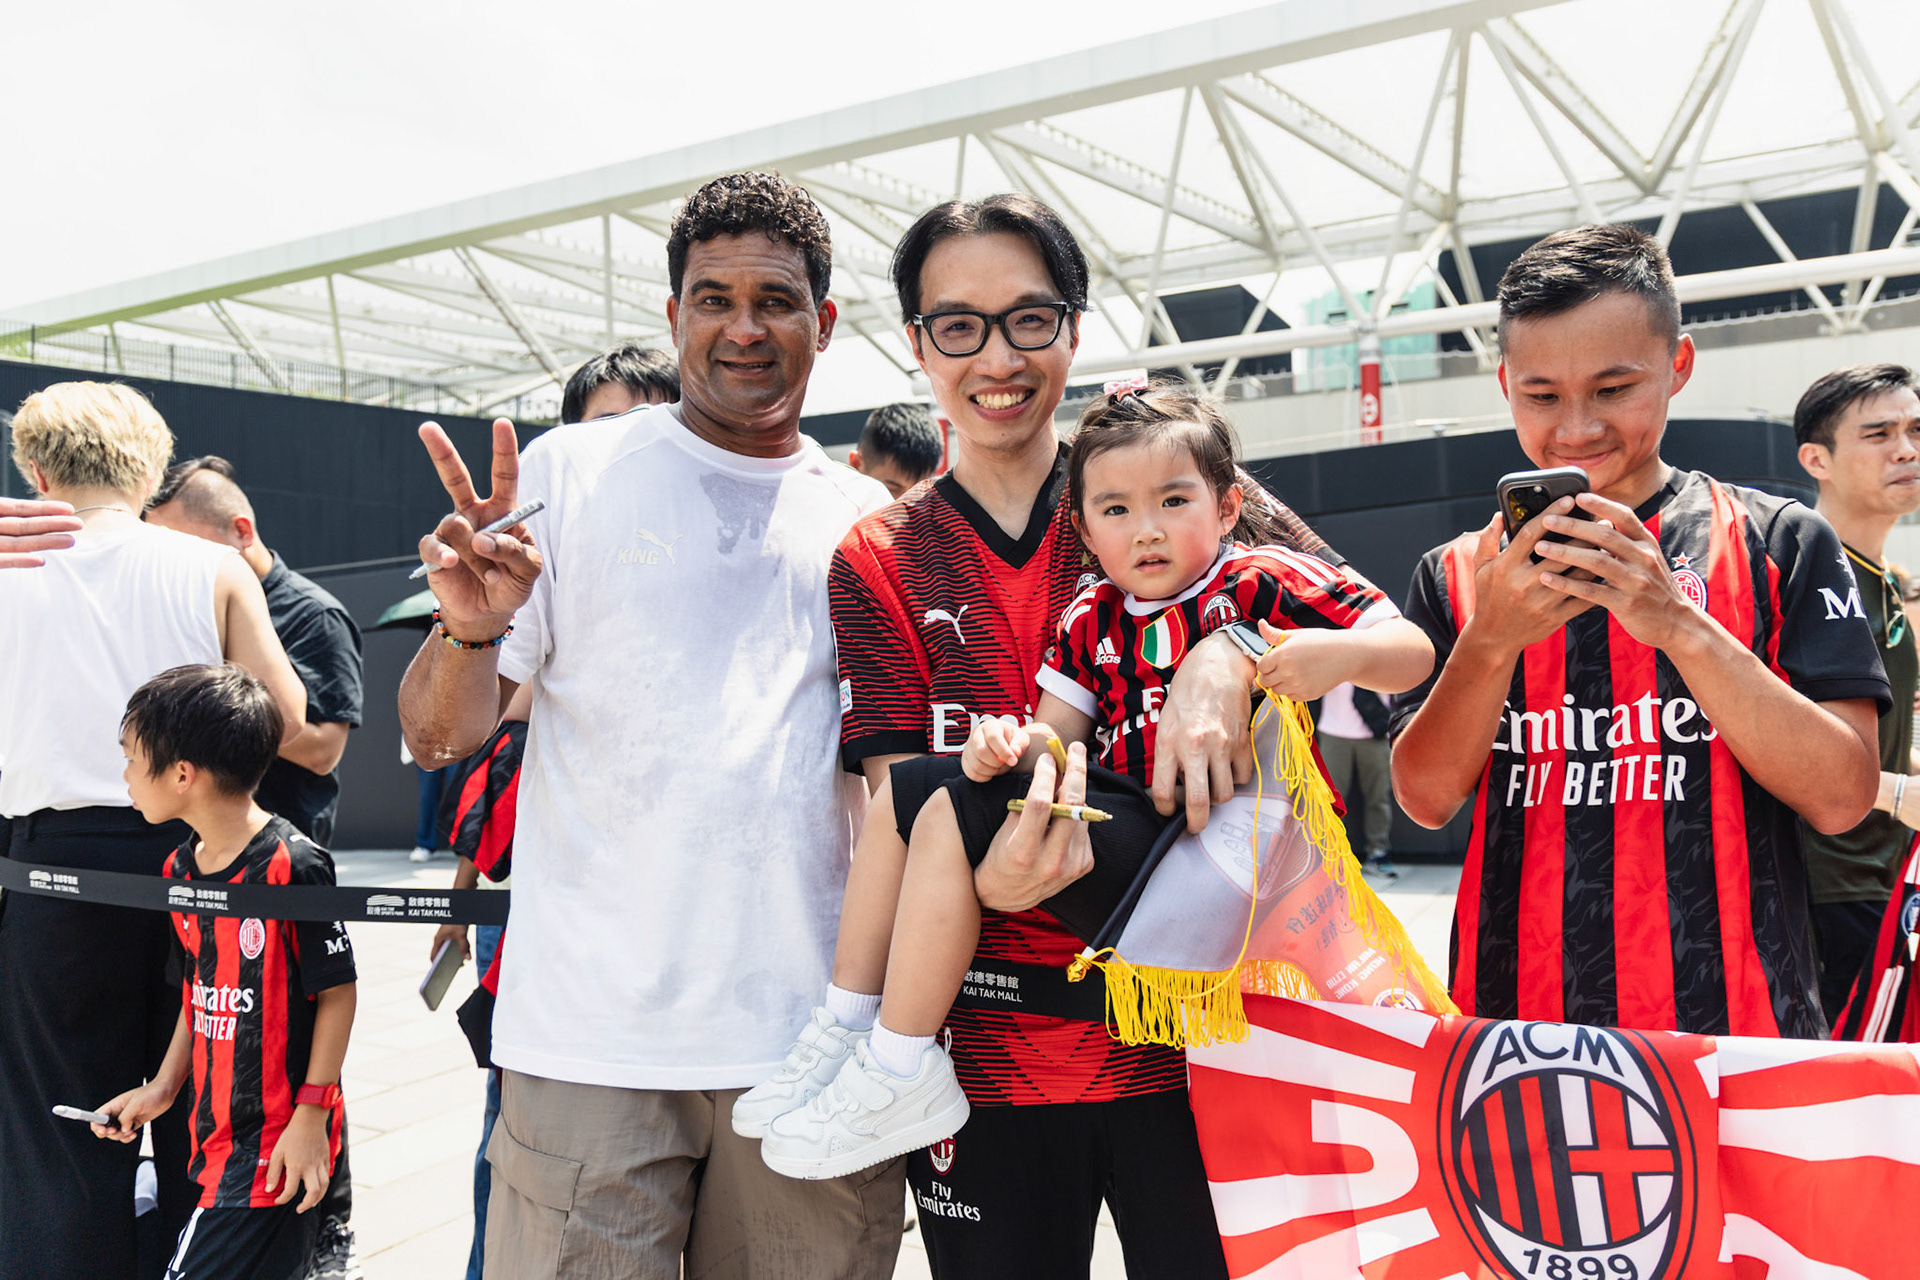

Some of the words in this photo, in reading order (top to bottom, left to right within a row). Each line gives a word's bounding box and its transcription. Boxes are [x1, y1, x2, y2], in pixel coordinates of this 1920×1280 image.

[616, 547, 660, 566] KING
[1506, 761, 1553, 807] FLY
[1562, 754, 1688, 806] BETTER
[408, 909, 420, 917] KAI
[421, 909, 433, 917] TAK
[434, 909, 452, 917] MALL
[191, 979, 254, 1013] mirates
[963, 985, 977, 996] KAI
[979, 987, 996, 999] TAK
[997, 990, 1023, 1003] MALL
[1482, 1022, 1625, 1085] ACM
[933, 1158, 949, 1168] 1899
[932, 1180, 952, 1201] Fly
[917, 1188, 981, 1222] Emirates
[1523, 1248, 1639, 1280] 1899
